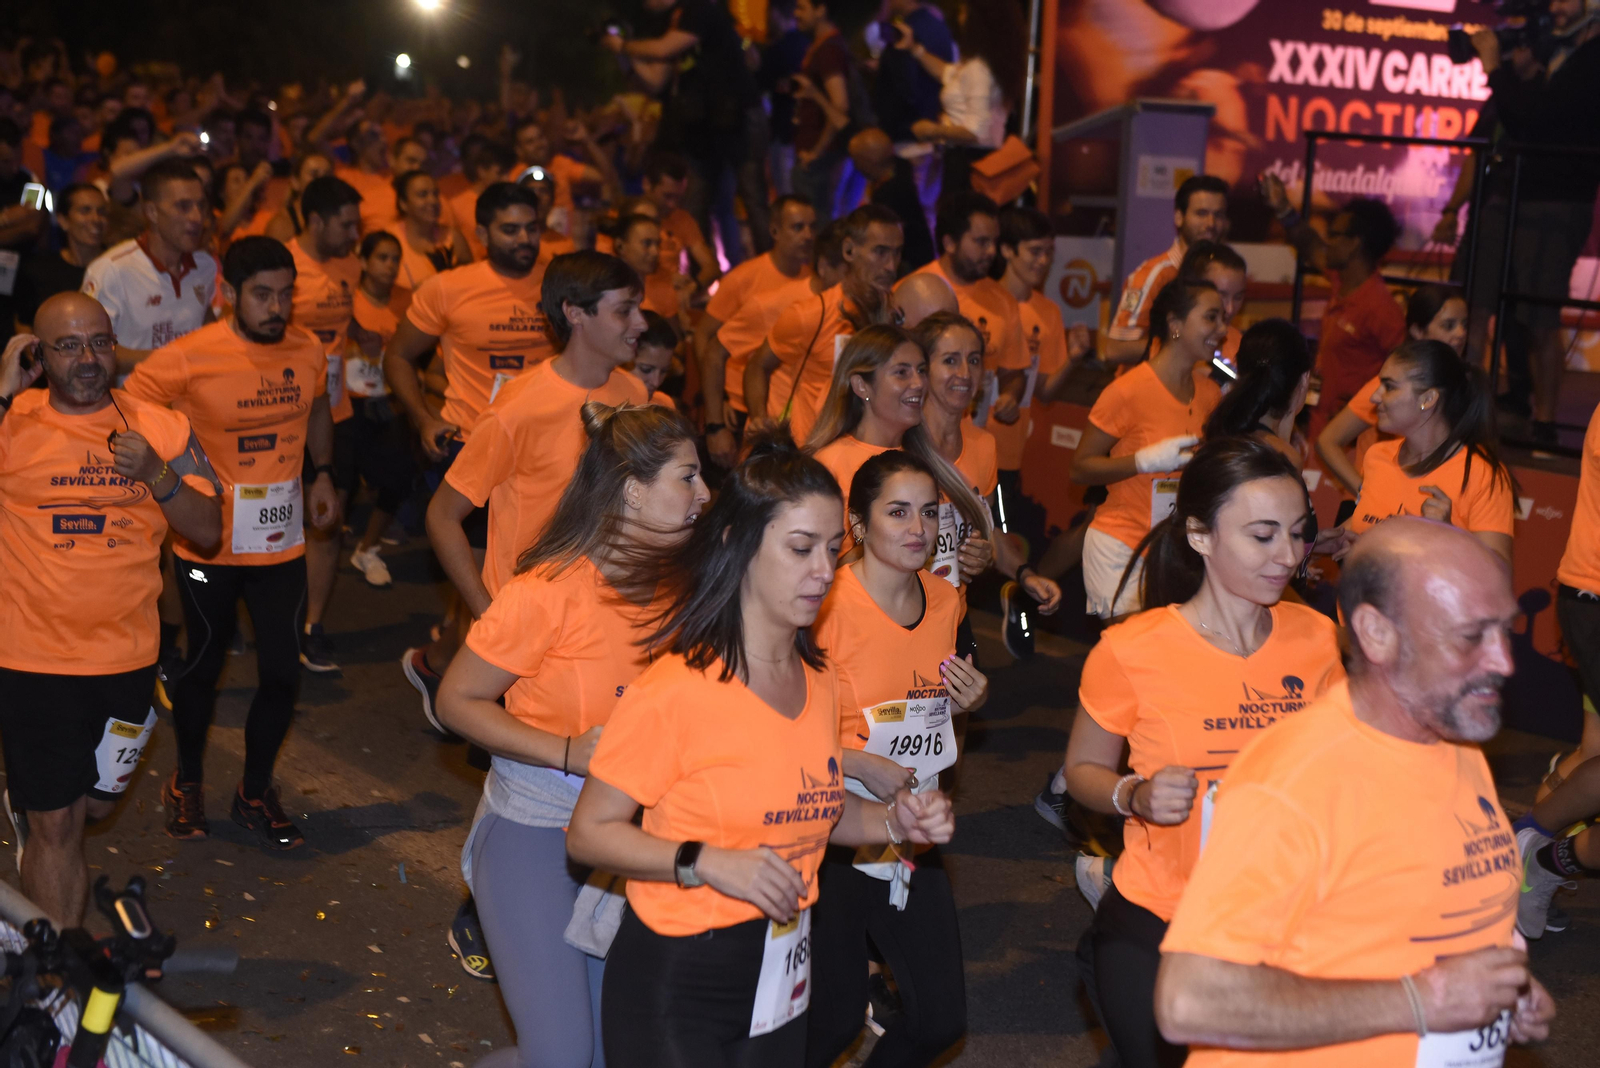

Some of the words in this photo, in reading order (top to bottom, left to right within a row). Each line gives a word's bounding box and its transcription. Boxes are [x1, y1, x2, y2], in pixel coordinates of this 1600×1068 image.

[1322, 8, 1342, 31] 30
[1343, 12, 1365, 33] de
[1268, 38, 1381, 91] XXXIV
[237, 397, 278, 409] SEVILLA
[256, 385, 301, 398] NOCTURNA
[50, 476, 106, 487] SEVILLA
[889, 732, 944, 757] 19916
[763, 807, 820, 826] SEVILLA
[1463, 831, 1513, 857] NOCTURNA
[1442, 860, 1493, 888] SEVILLA
